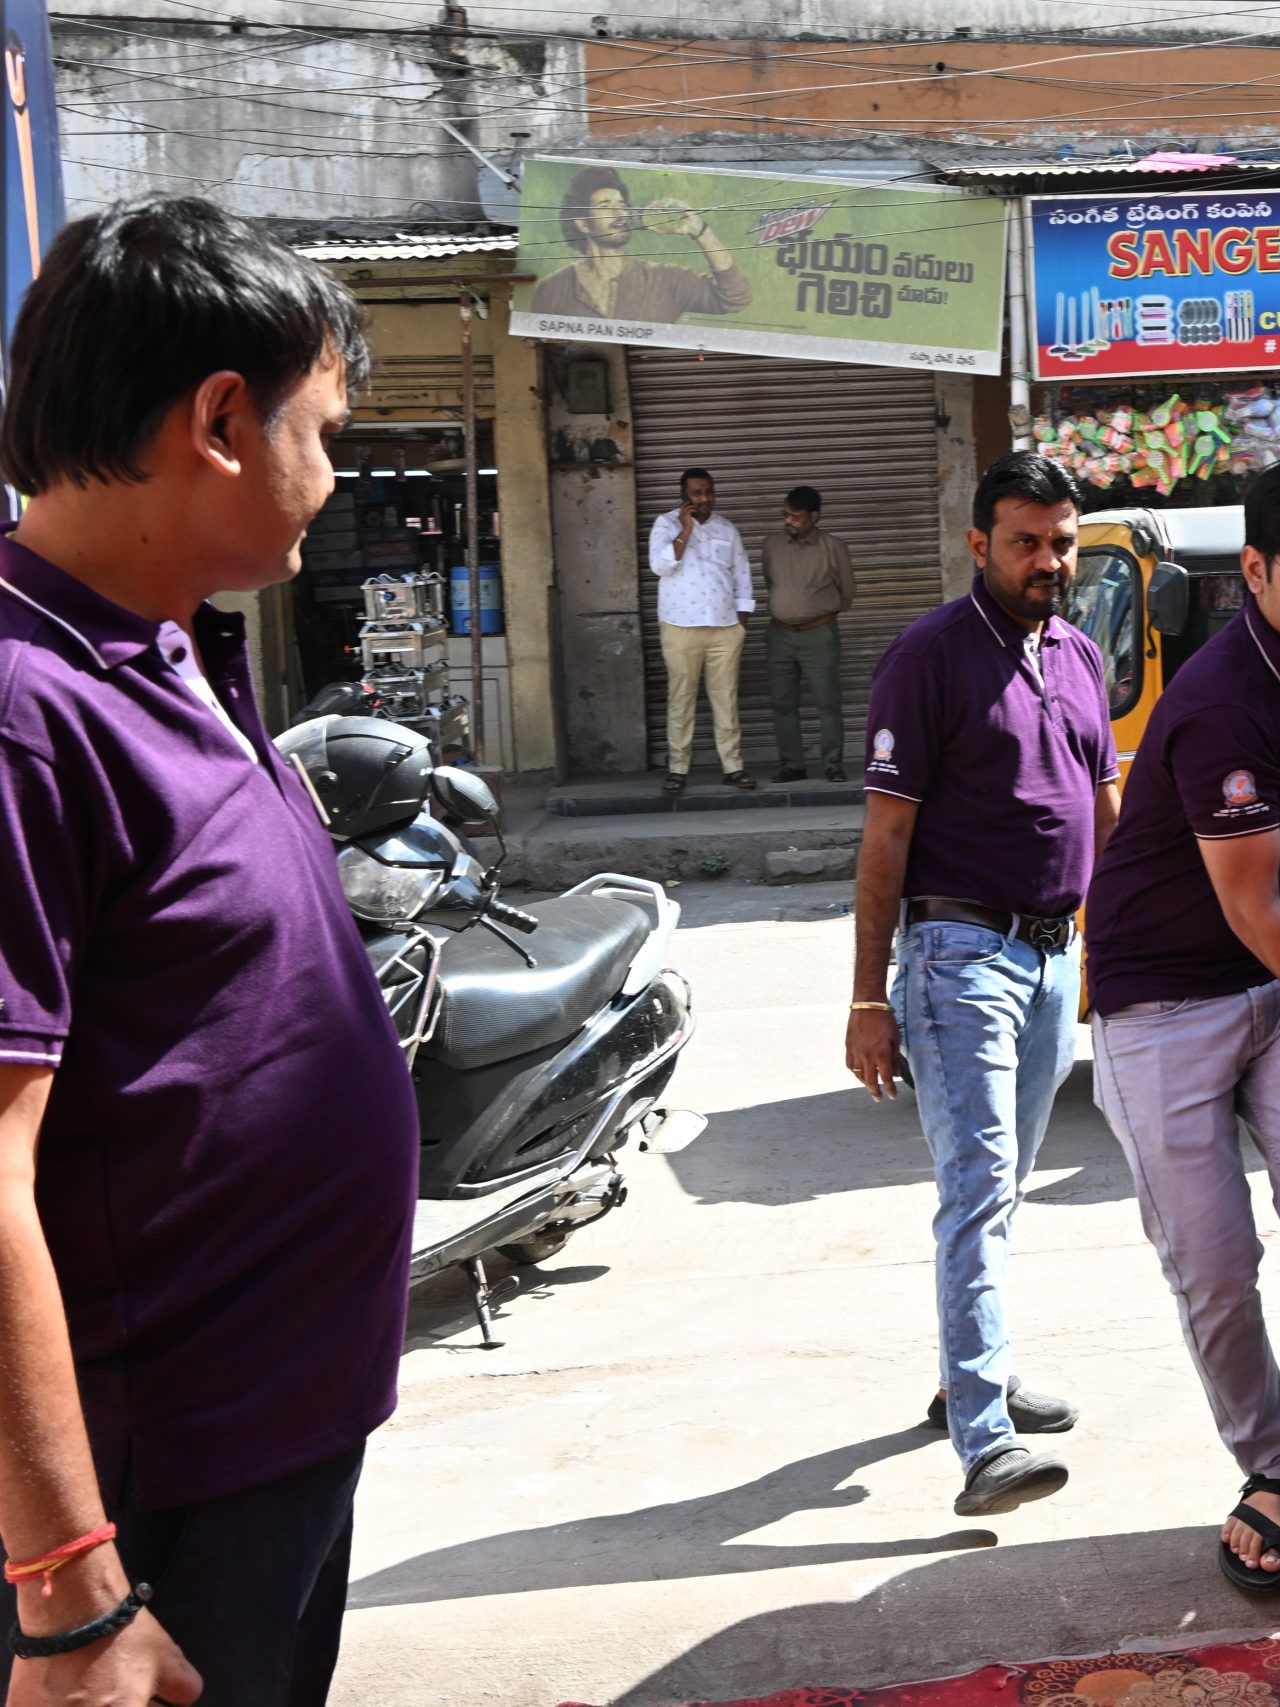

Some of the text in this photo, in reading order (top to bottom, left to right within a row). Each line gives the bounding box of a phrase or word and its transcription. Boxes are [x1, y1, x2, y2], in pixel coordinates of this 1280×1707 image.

[1049, 206, 1119, 225] సంగీత
[538, 319, 654, 340] SAPNA PAN SHOP
